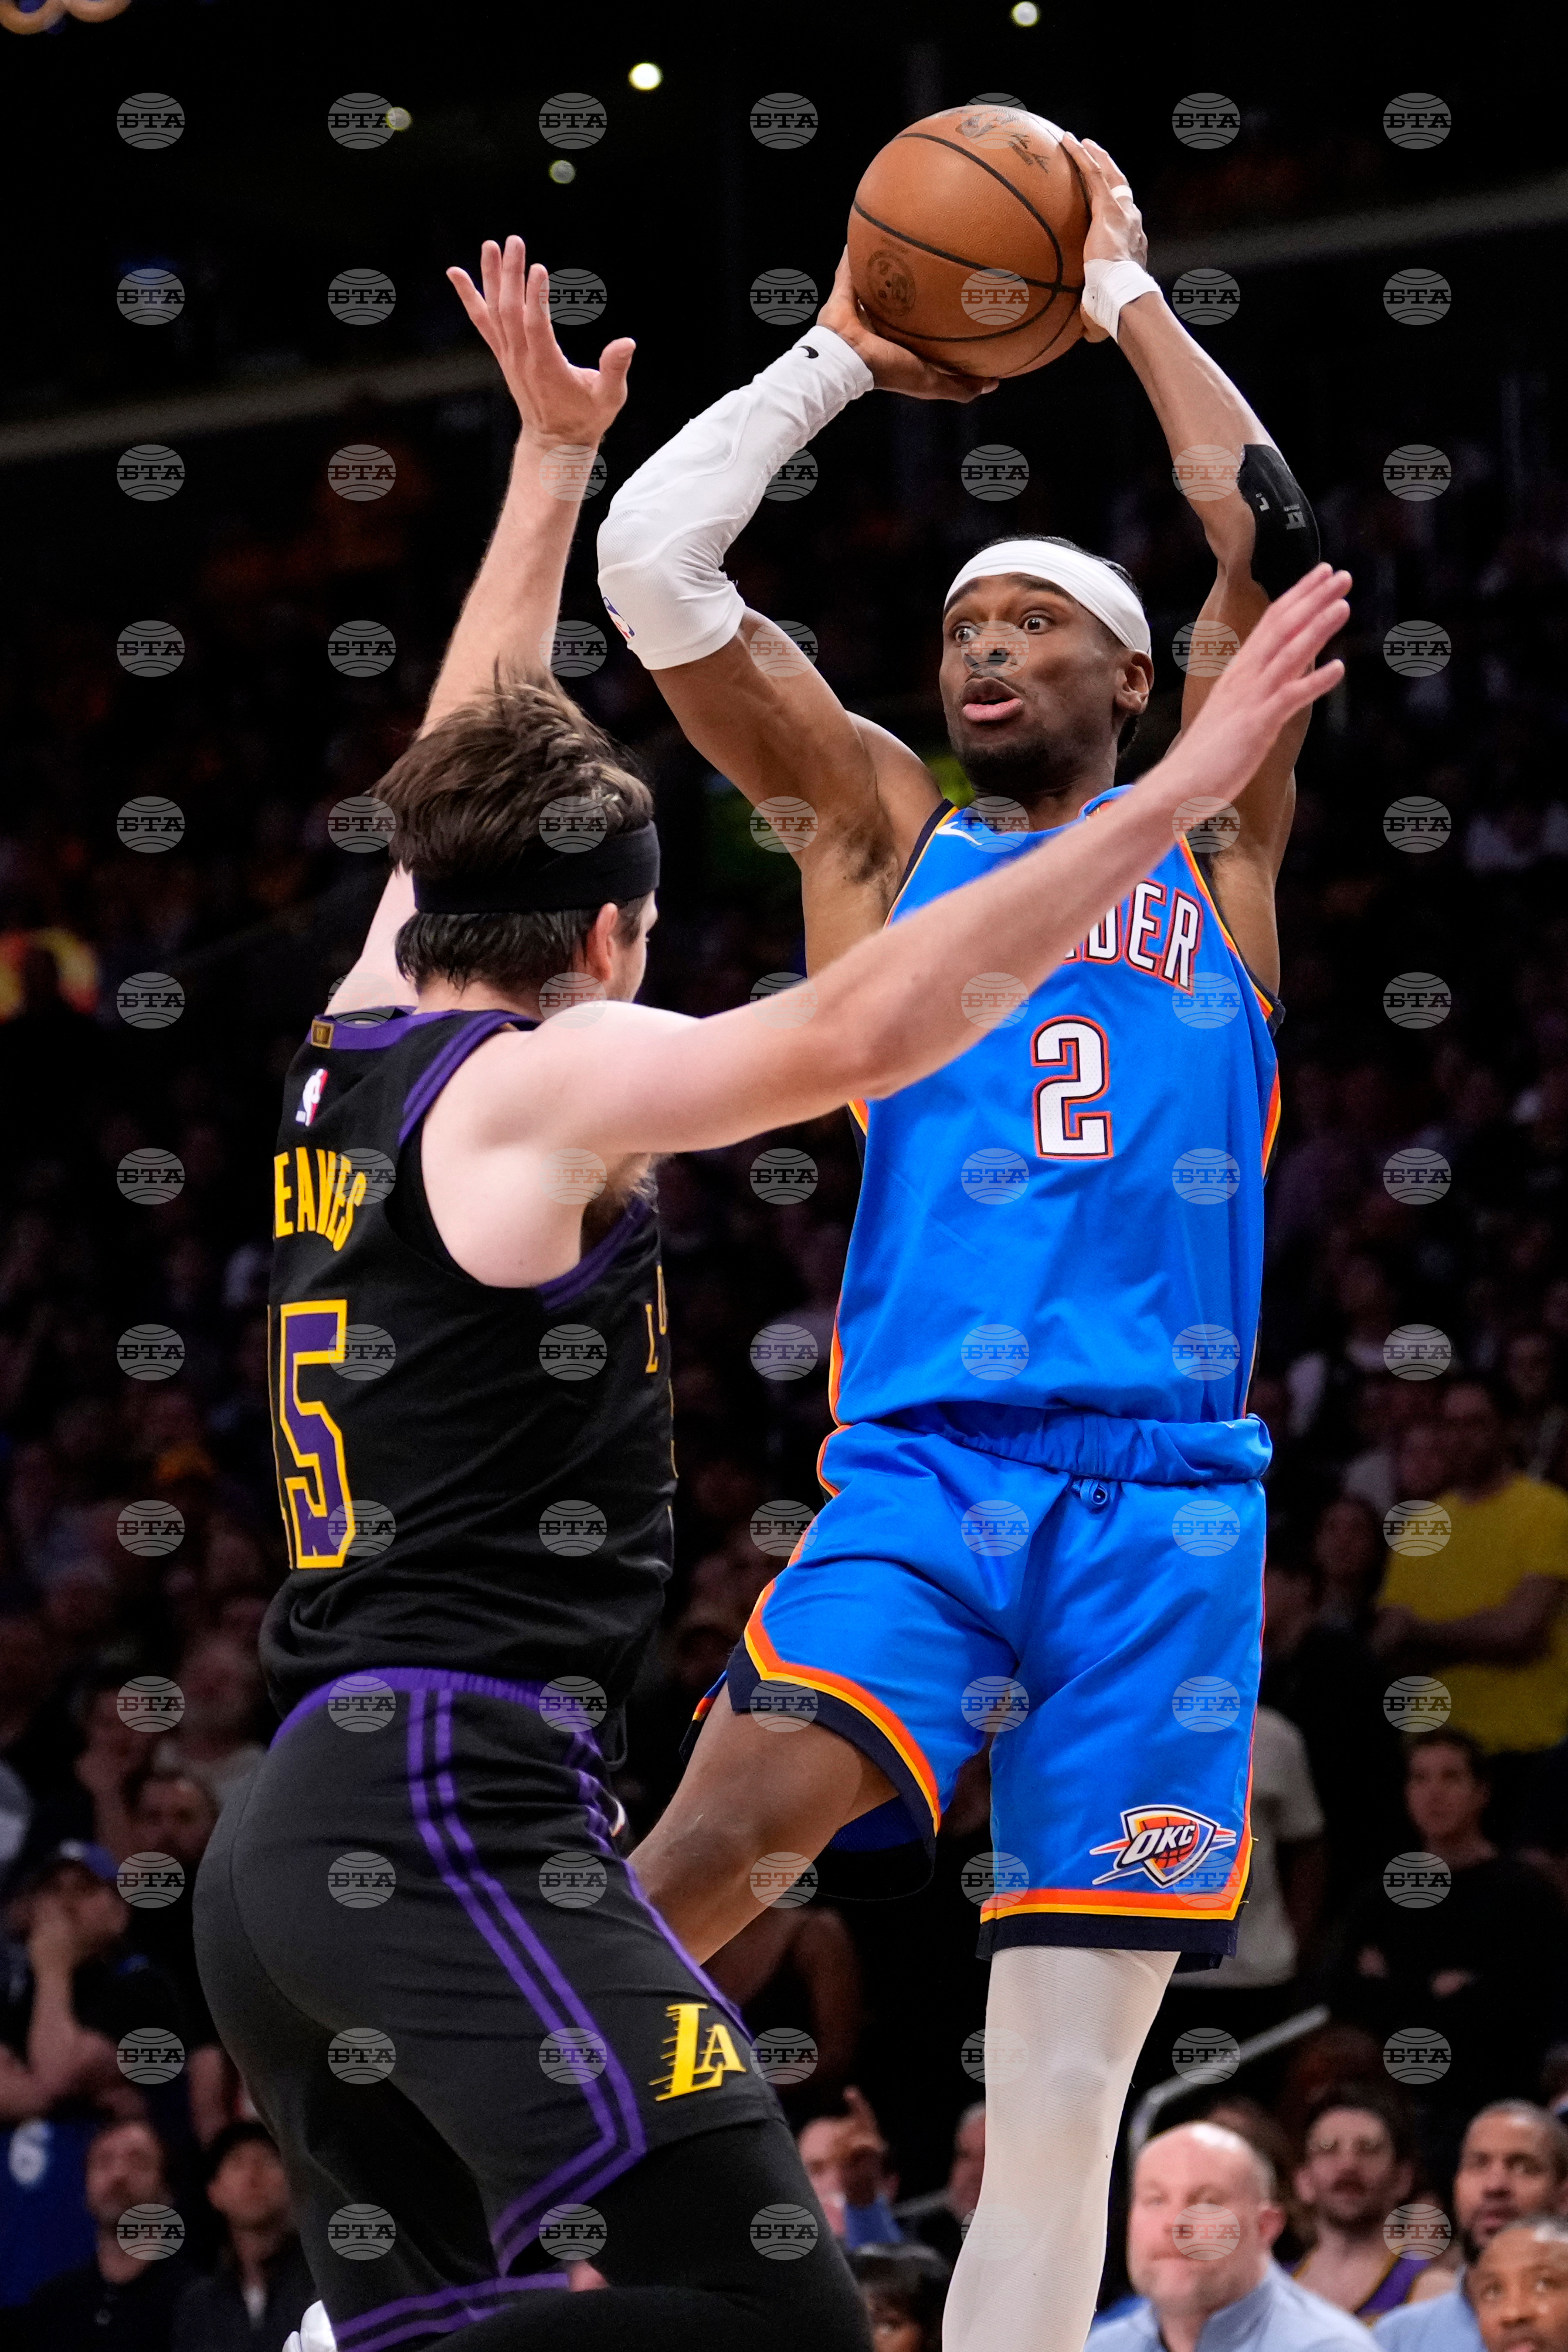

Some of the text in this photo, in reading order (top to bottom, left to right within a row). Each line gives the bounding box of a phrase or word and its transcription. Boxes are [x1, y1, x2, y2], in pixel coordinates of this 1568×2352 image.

[1060, 878, 1203, 996] DER
[1030, 1015, 1113, 1160] 2
[268, 1299, 356, 1569] 5
[1117, 1824, 1197, 1868] OKC
[649, 2003, 746, 2102] LA
